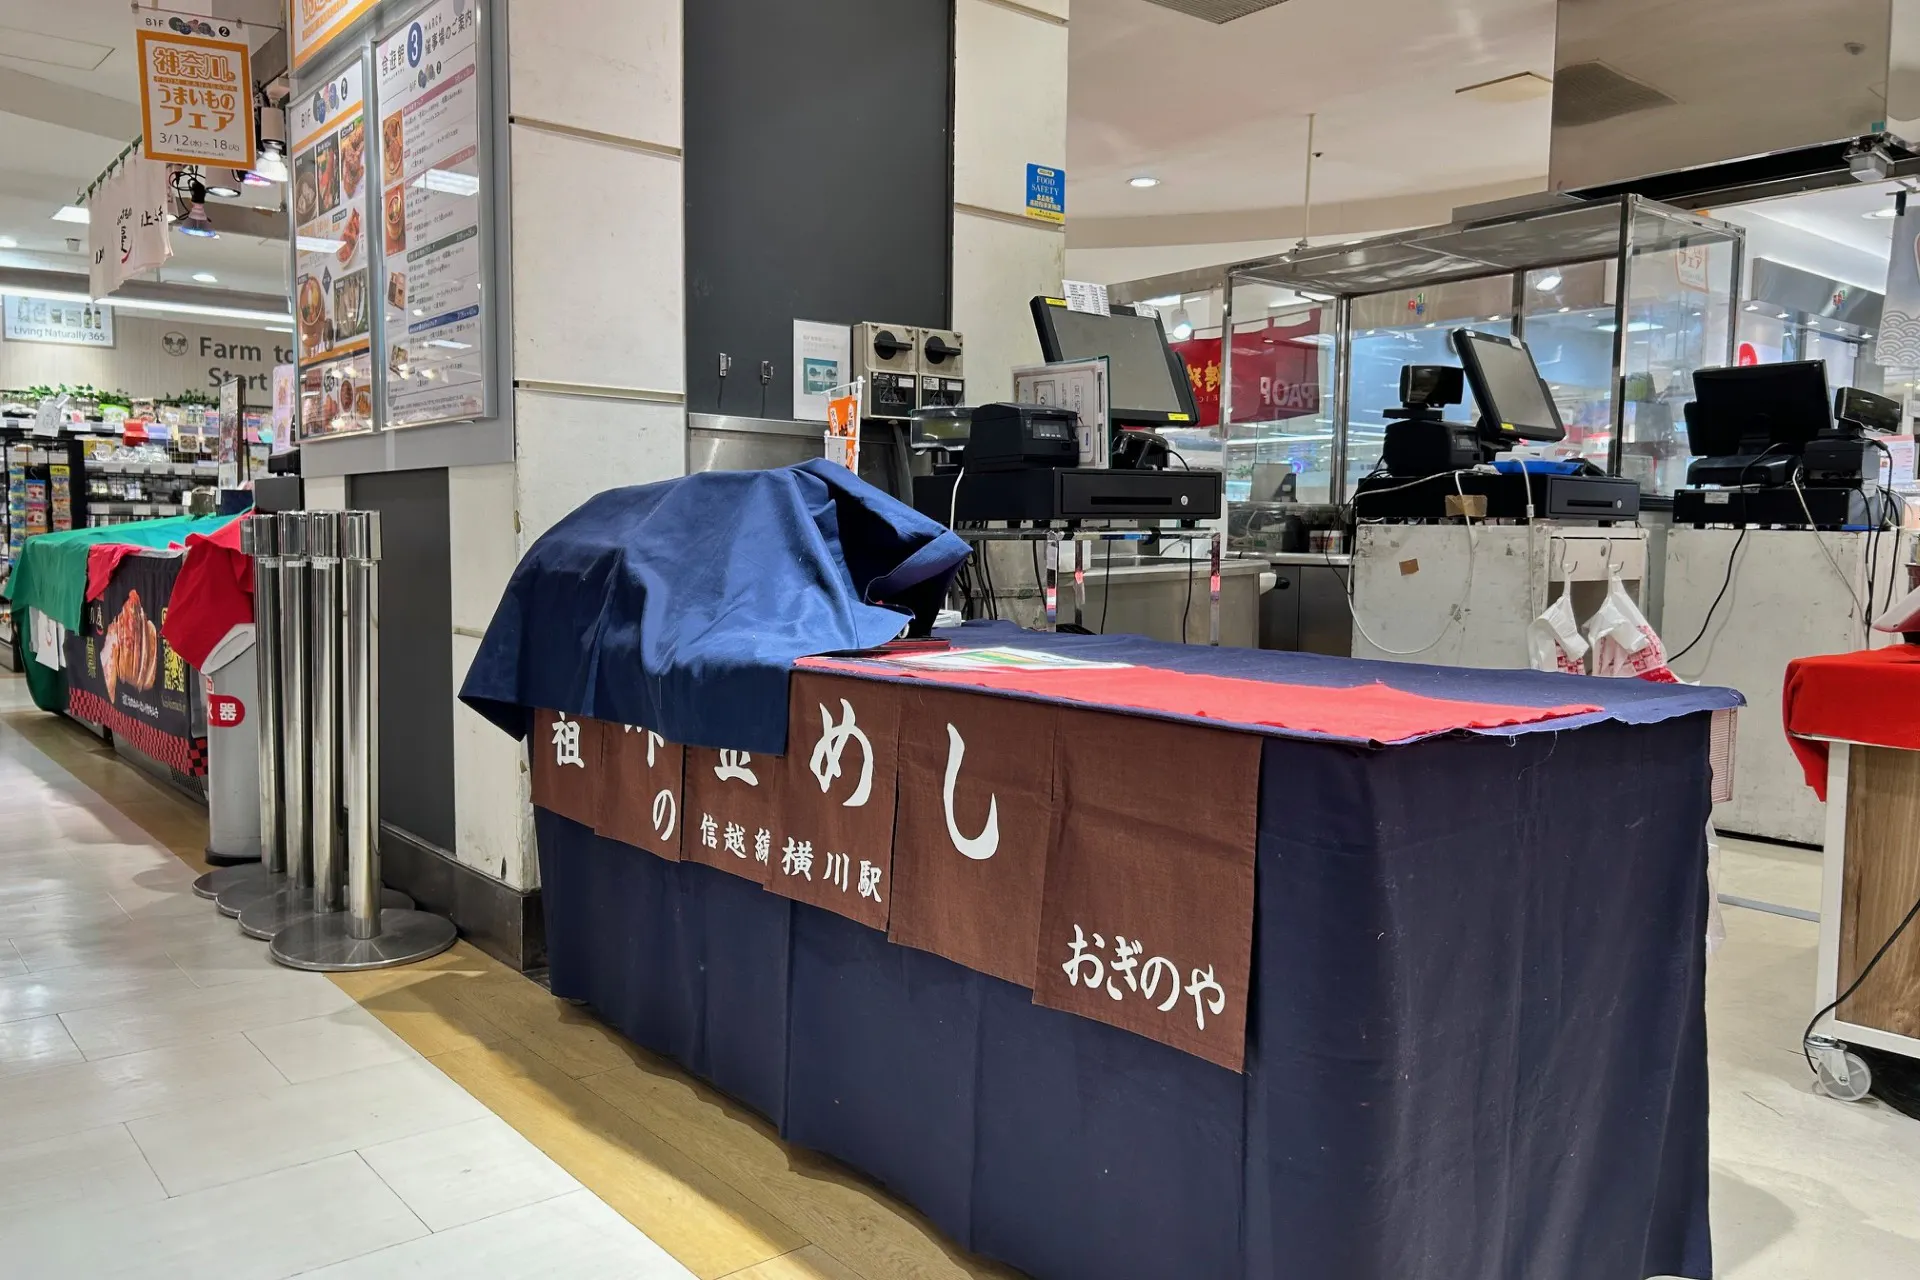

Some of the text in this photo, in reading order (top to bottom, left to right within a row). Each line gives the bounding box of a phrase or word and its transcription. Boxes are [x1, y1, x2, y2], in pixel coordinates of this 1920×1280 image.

[145, 18, 164, 28] B1F
[158, 84, 235, 111] うまいもの
[160, 105, 234, 132] フェア
[1031, 184, 1059, 196] SAFETY
[1036, 176, 1055, 186] FOOD
[14, 325, 105, 342] Living Naturally 365
[199, 336, 261, 363] Farm
[1062, 923, 1226, 1031] おぎのや
